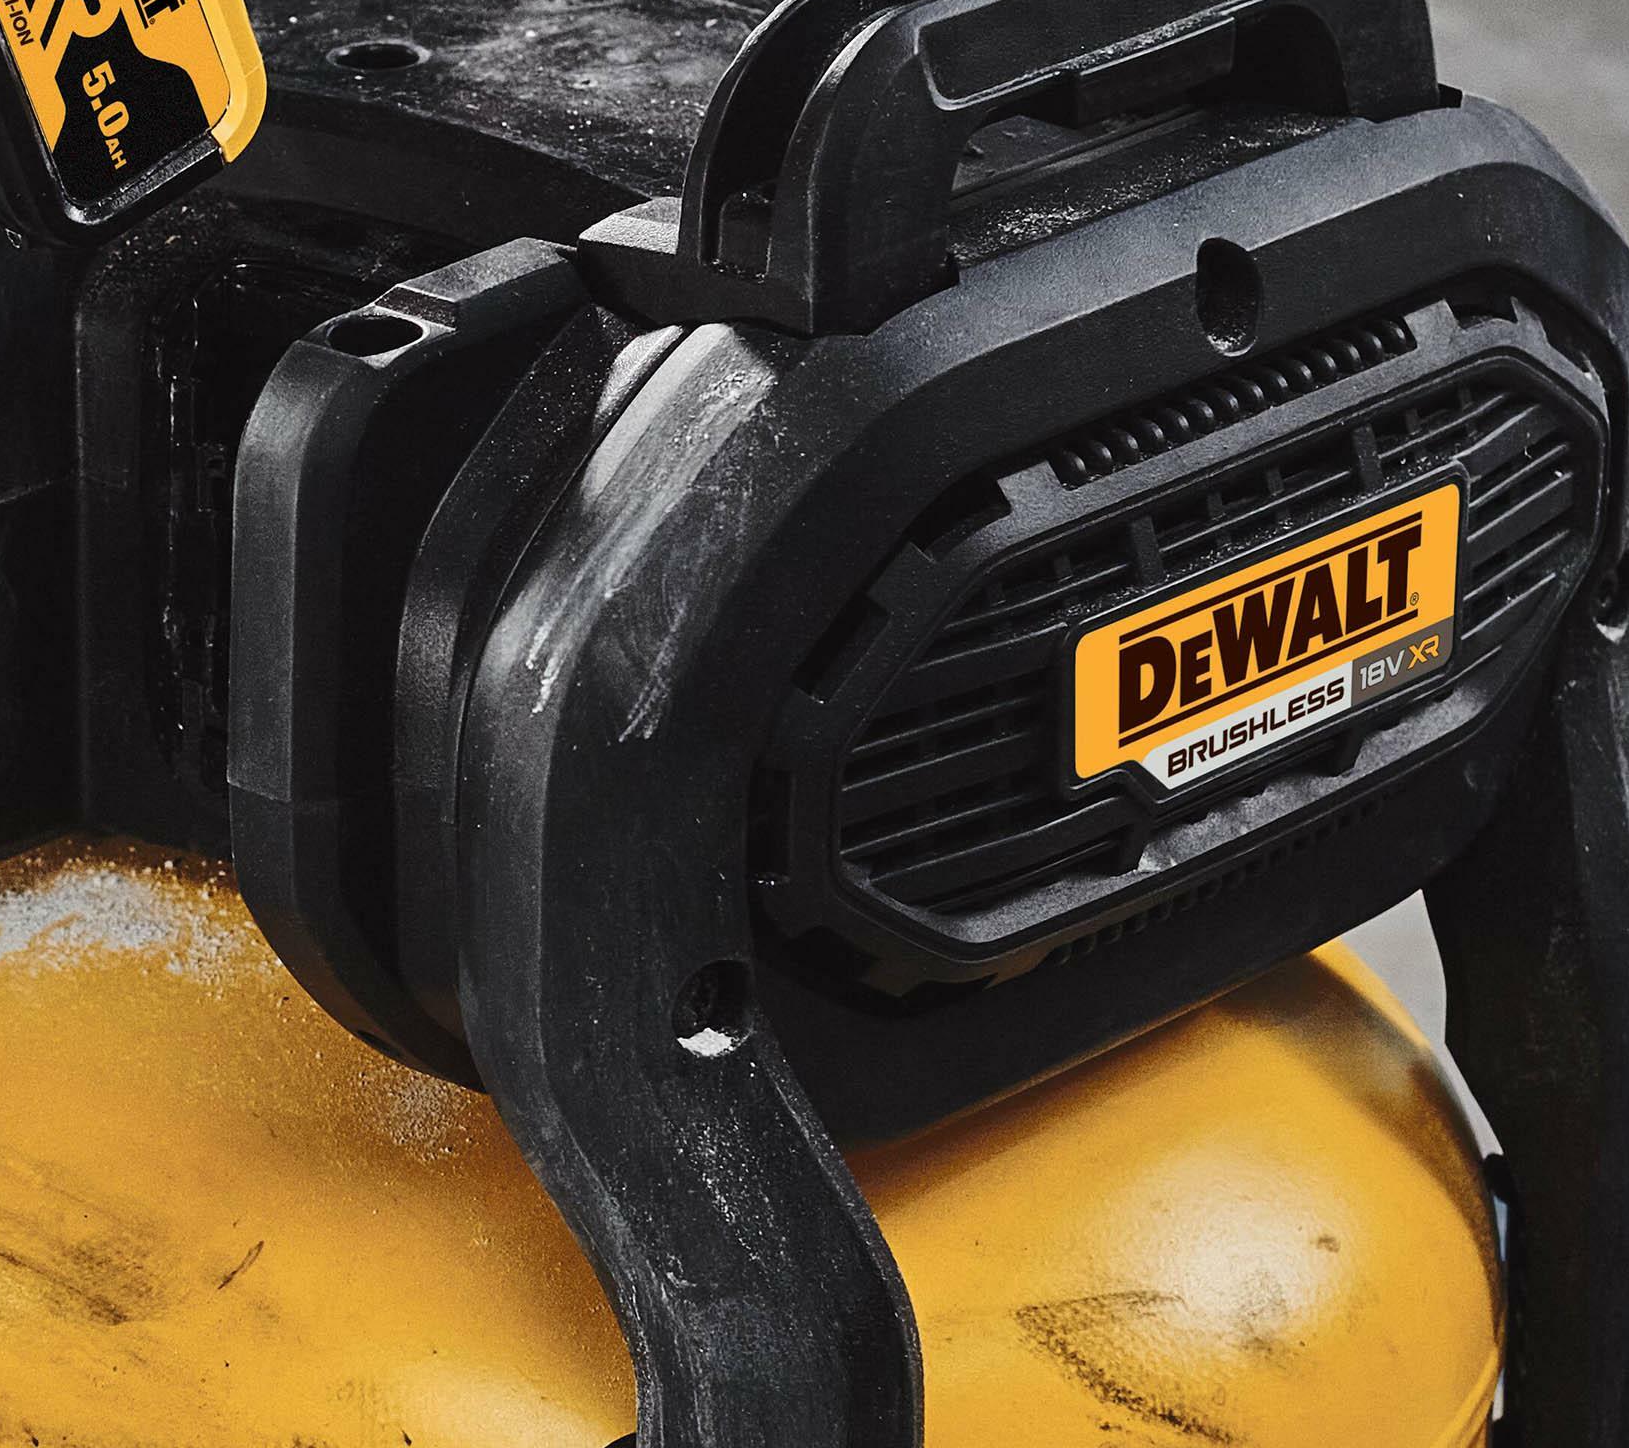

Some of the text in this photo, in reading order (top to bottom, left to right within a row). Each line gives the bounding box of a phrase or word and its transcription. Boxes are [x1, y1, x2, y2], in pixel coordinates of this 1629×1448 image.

[1118, 523, 1422, 735] DEWALT
[1166, 634, 1440, 779] BRUSHLESS 18V XR
